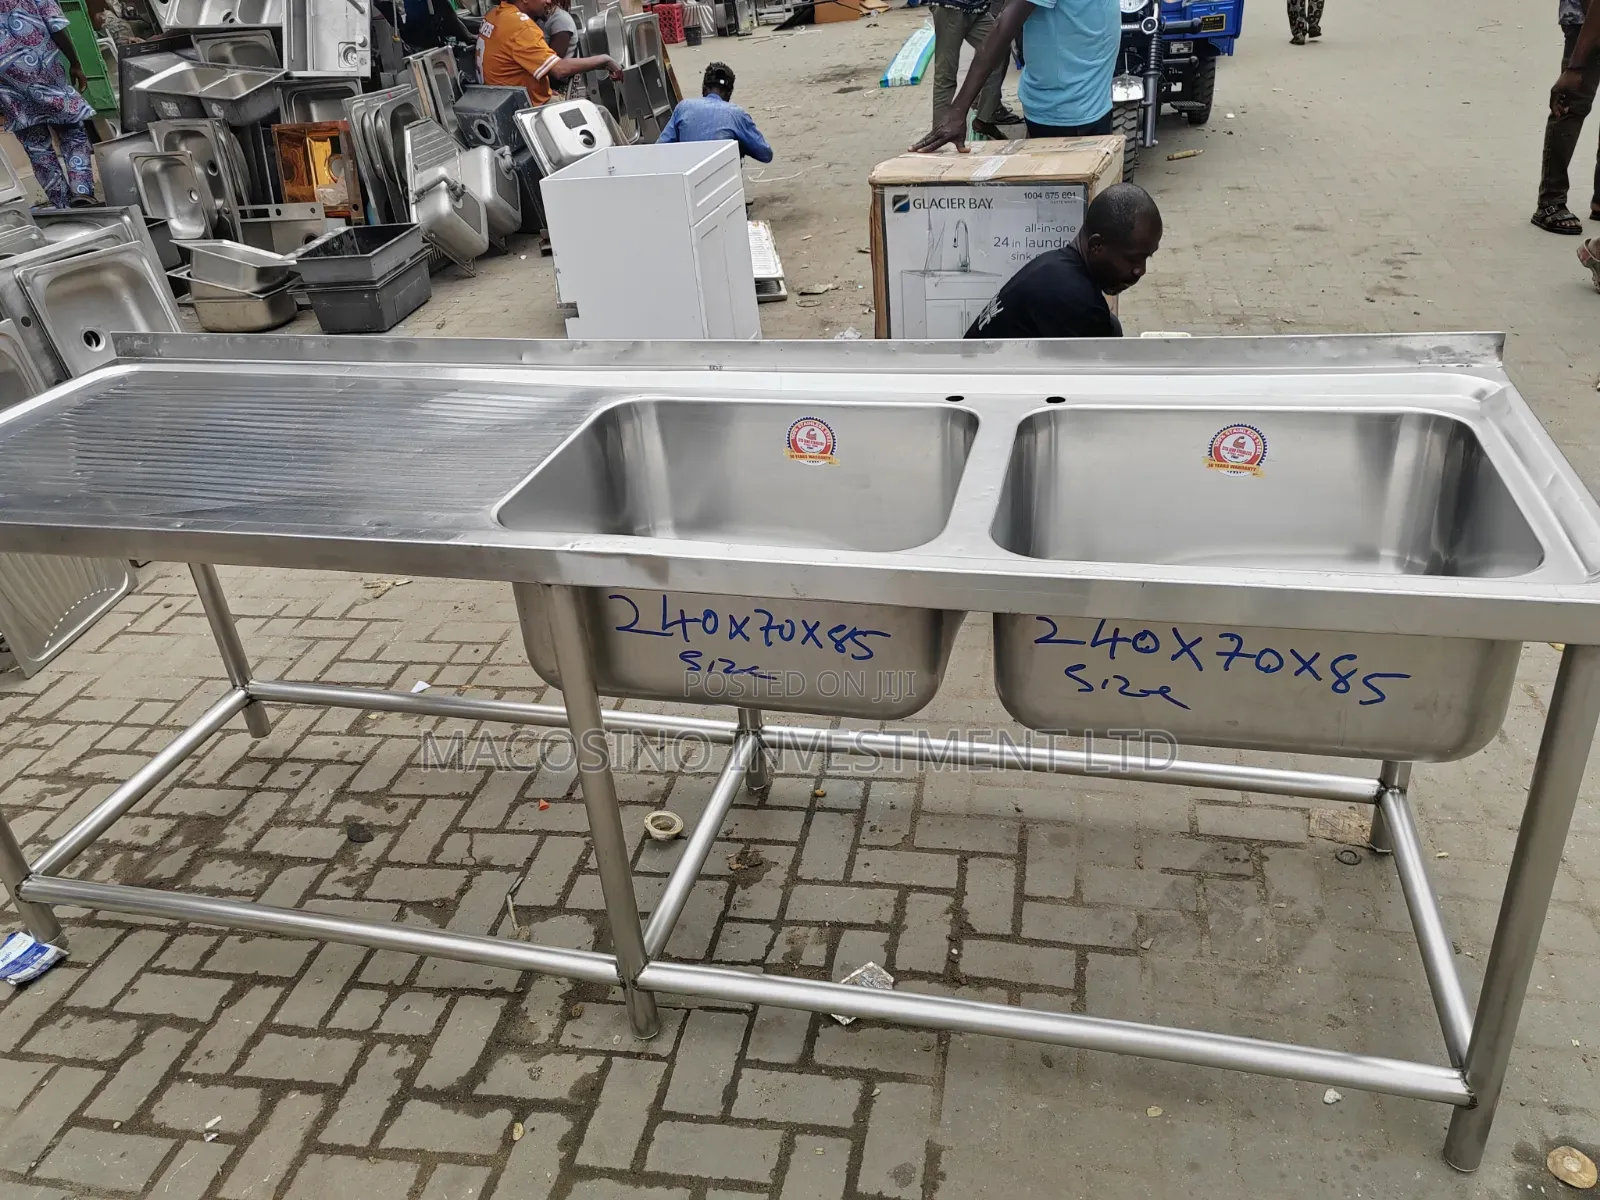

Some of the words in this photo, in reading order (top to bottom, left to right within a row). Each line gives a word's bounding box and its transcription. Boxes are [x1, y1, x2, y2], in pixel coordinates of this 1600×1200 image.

[1023, 191, 1043, 200] 1004
[1044, 191, 1060, 200] 675
[912, 197, 966, 210] GLACIER
[1024, 223, 1077, 233] all-in-one
[993, 236, 1010, 248] 24
[1011, 238, 1021, 248] in
[1010, 251, 1032, 261] sink
[1226, 428, 1256, 439] STAINLESS
